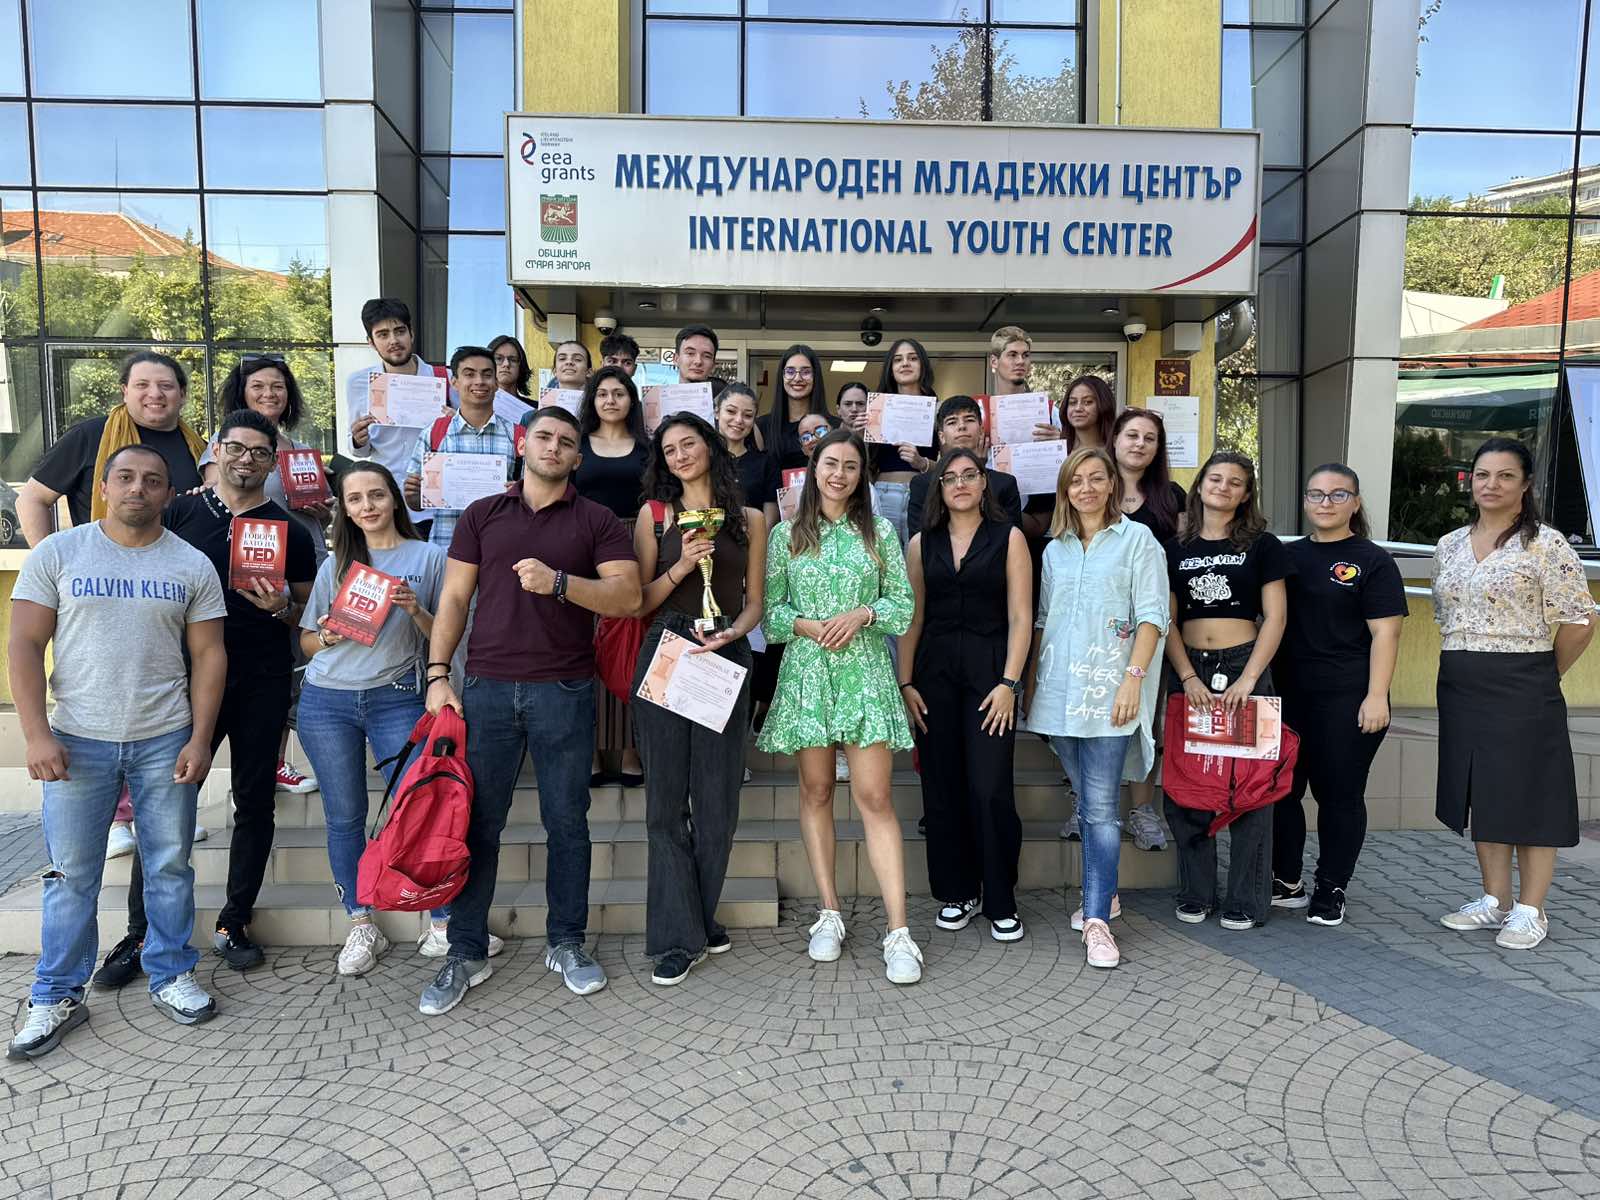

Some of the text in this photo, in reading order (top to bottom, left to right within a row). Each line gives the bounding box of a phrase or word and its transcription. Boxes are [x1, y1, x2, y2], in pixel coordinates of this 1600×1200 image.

[541, 152, 572, 165] eea
[541, 165, 595, 184] grants
[615, 153, 1243, 203] МЕЖДУНАРОДЕН МЛАДЕЖКИ ЦЕНТЪР
[689, 215, 1174, 257] INTERNATIONAL YOUTH CENTER
[538, 248, 578, 258] ОБЩИНА
[525, 259, 591, 270] СТАРА ЗАГОРА
[293, 472, 317, 485] TED
[243, 547, 275, 562] TED
[72, 578, 186, 603] CALVIN KLEIN
[349, 591, 378, 613] TED
[1068, 661, 1122, 686] NEVER
